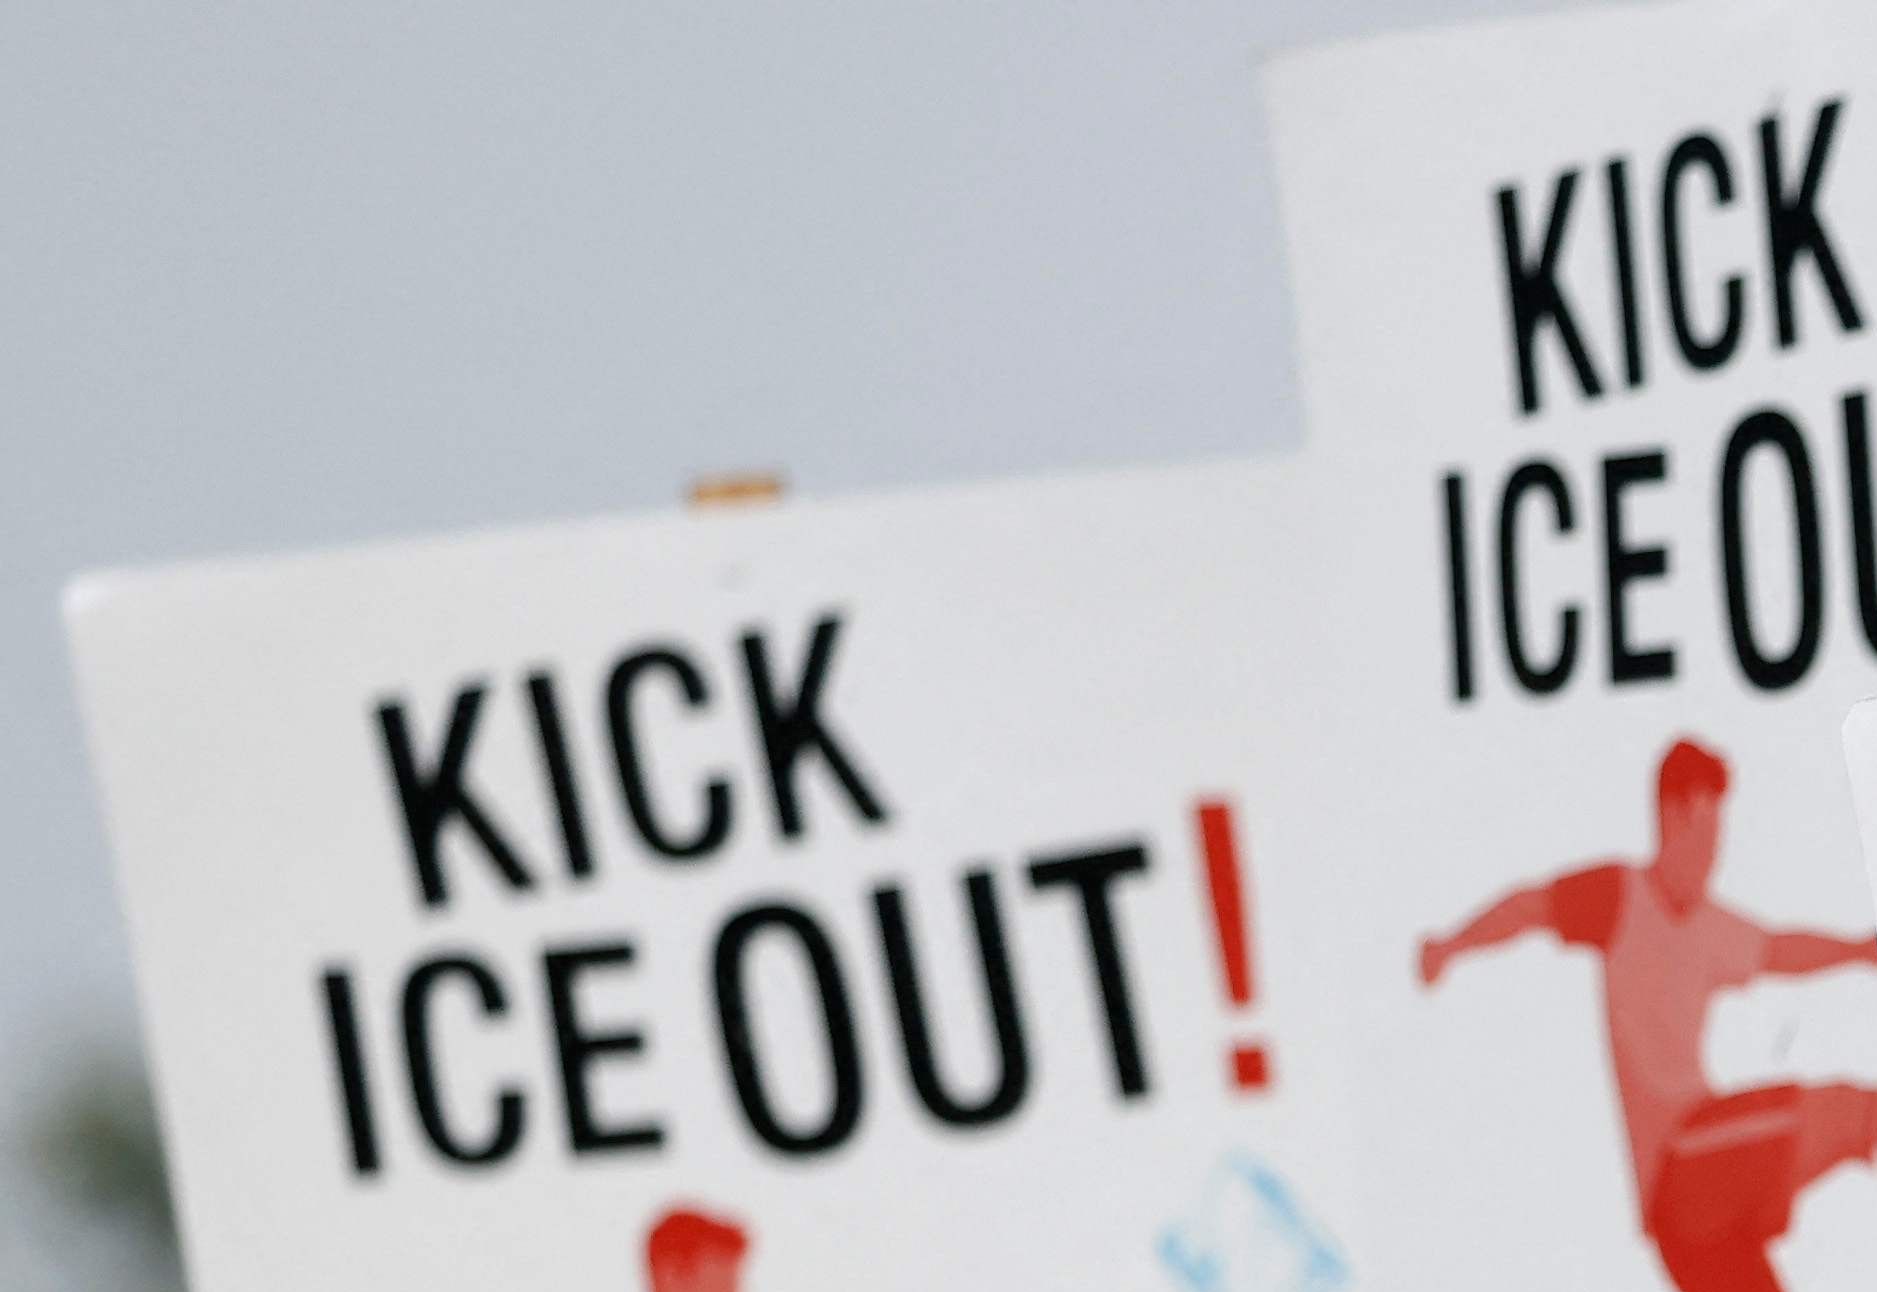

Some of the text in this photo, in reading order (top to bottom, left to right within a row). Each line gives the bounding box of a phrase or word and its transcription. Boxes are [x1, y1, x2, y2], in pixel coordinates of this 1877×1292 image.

[1494, 99, 1864, 417] KICK
[1442, 448, 1677, 702] ICE
[373, 614, 888, 911] KICK
[320, 801, 1271, 1178] ICE OUT!
